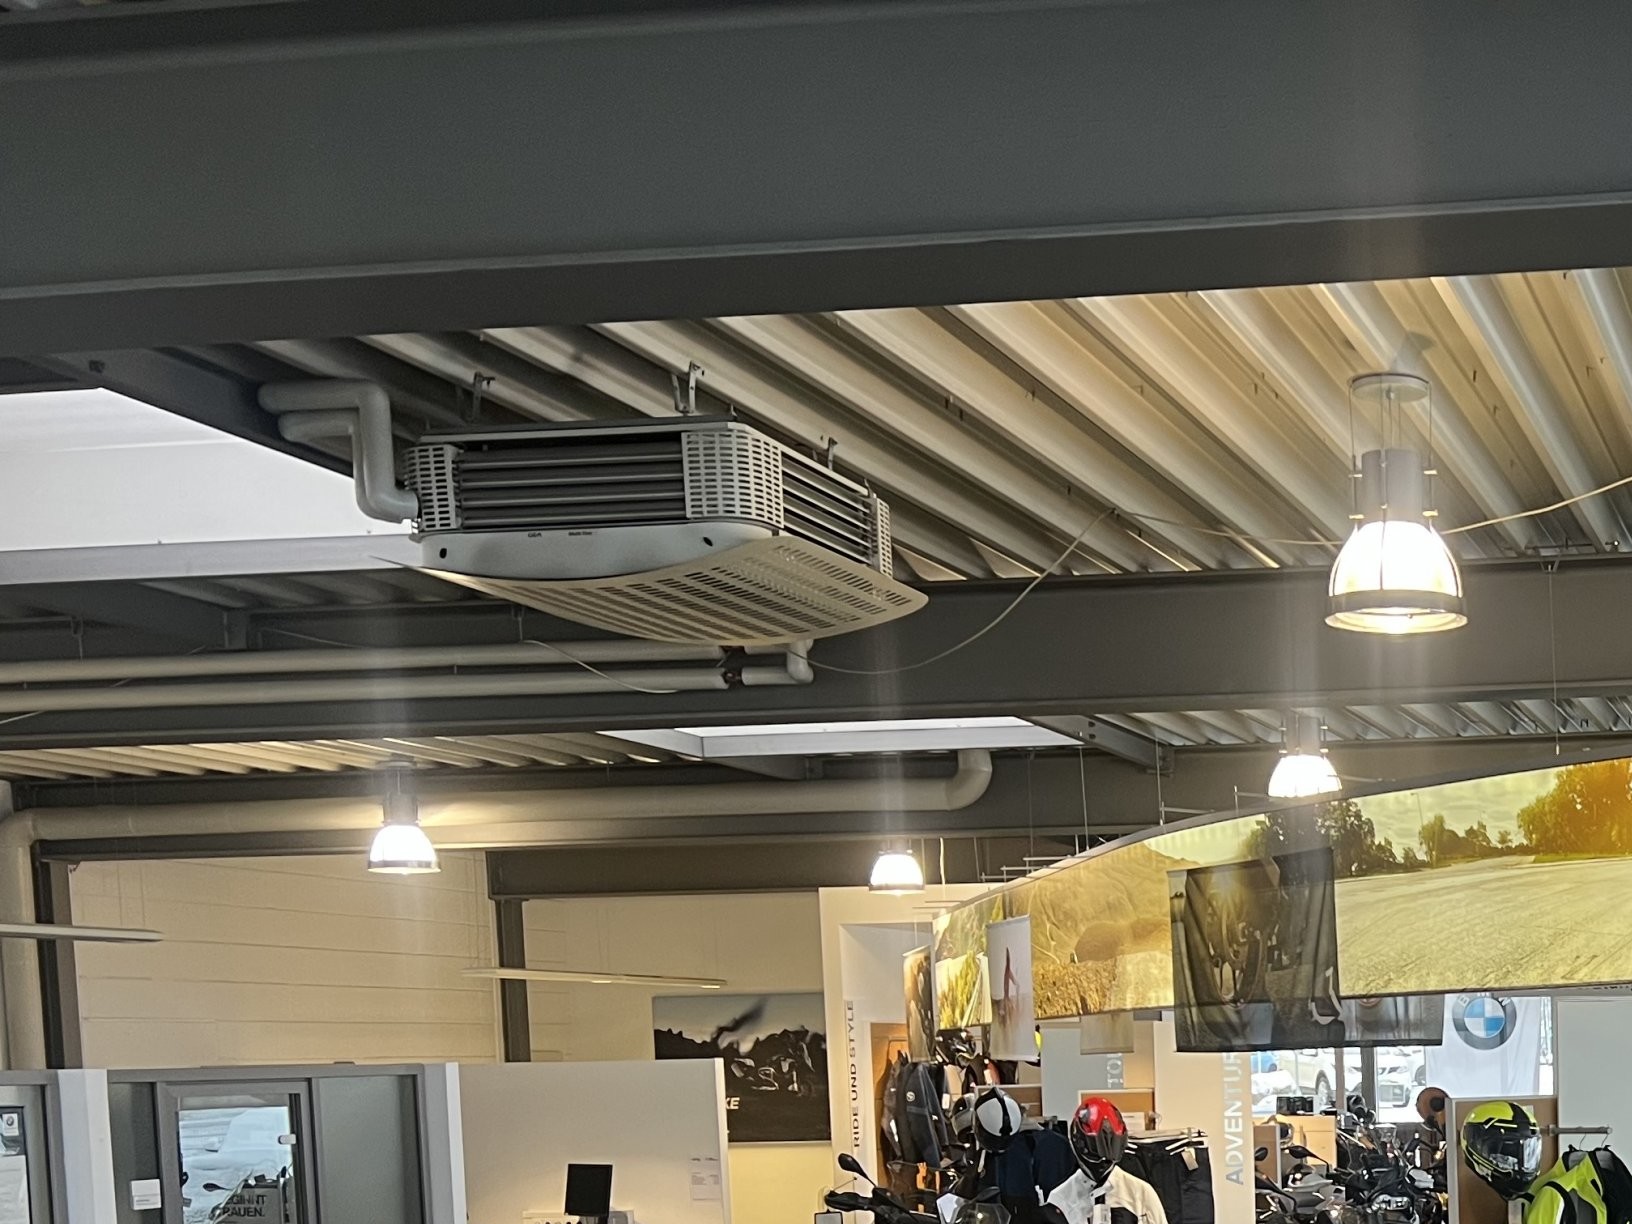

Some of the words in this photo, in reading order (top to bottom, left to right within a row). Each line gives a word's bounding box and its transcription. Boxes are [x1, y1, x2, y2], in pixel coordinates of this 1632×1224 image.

[846, 1001, 856, 1058] STYLE
[850, 1064, 858, 1102] UND
[852, 1106, 860, 1148] RIDE
